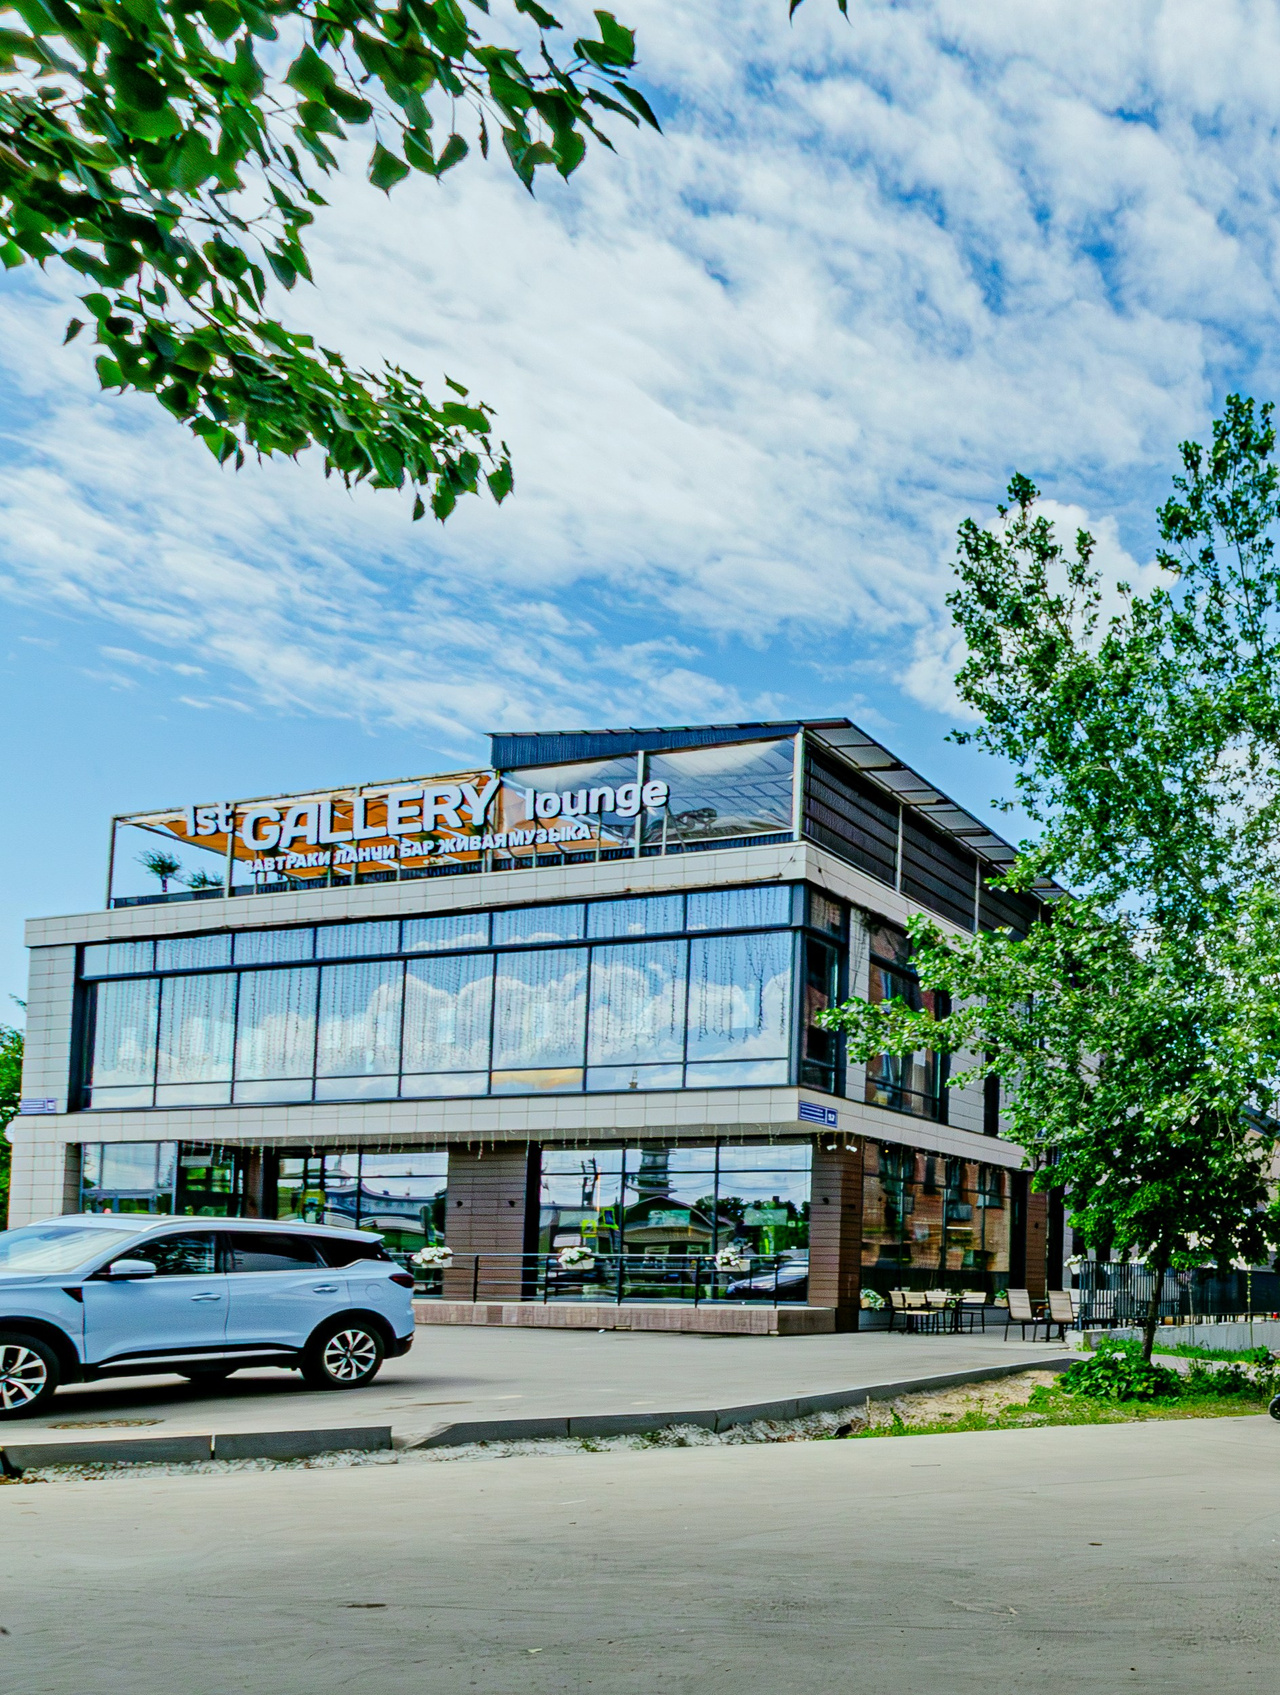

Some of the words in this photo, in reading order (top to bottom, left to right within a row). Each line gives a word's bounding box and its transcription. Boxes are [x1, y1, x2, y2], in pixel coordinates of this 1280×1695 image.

[242, 771, 501, 851] GALLERY
[524, 779, 669, 821] lounge
[244, 852, 332, 873] ЗАВТРАКИ
[333, 844, 396, 865] ЛАНЧИ
[399, 840, 434, 859] БАР
[437, 832, 507, 854] ЖИВАЯ
[508, 823, 592, 847] МУЗЫКА
